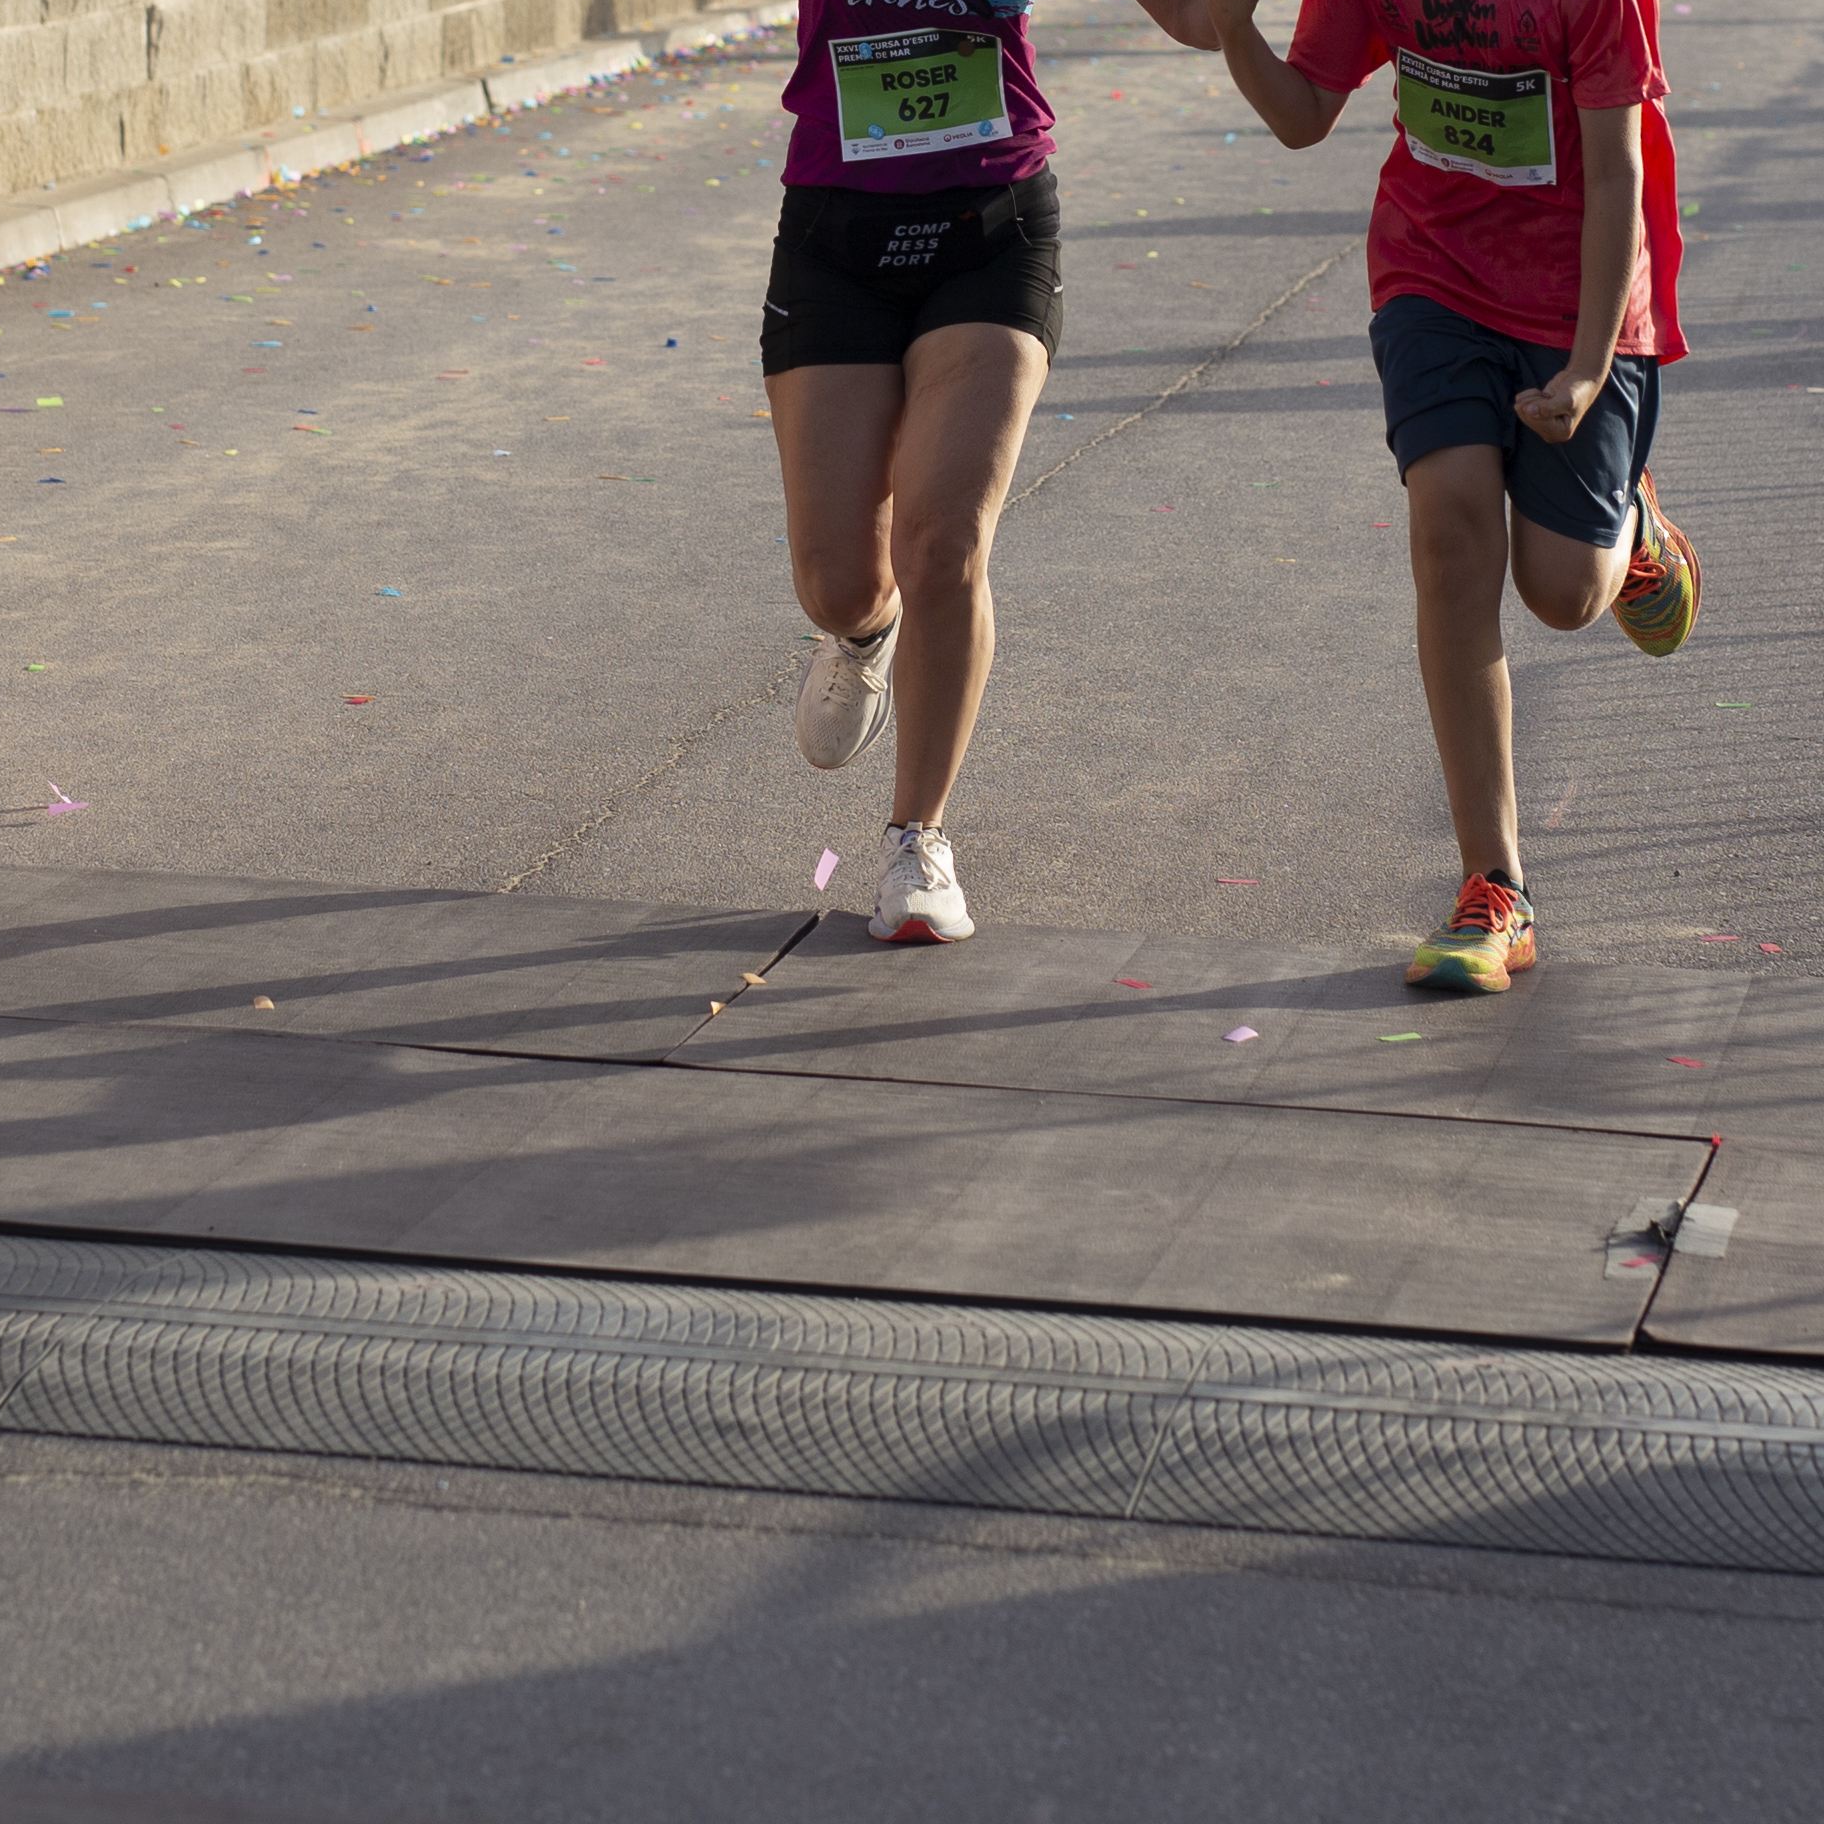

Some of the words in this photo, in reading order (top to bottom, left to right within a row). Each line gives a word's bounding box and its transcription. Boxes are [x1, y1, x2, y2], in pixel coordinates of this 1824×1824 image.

[836, 42, 867, 55] XXVI
[870, 39, 901, 52] CURSA
[902, 33, 940, 47] D'ESTIU
[838, 51, 873, 63] PREM
[875, 50, 888, 59] DE
[889, 48, 911, 59] MAR
[880, 63, 958, 92] ROSER
[1426, 65, 1452, 80] CURSA
[1453, 74, 1489, 87] D'ESTIU
[1429, 76, 1440, 86] DE
[1441, 80, 1461, 91] MAR
[1515, 79, 1536, 92] 5K
[897, 92, 951, 123] 627
[1430, 98, 1507, 128] ANDER
[1443, 125, 1496, 156] 824
[894, 222, 951, 236] COMP
[887, 238, 939, 252] RESS
[877, 252, 935, 267] PORT
